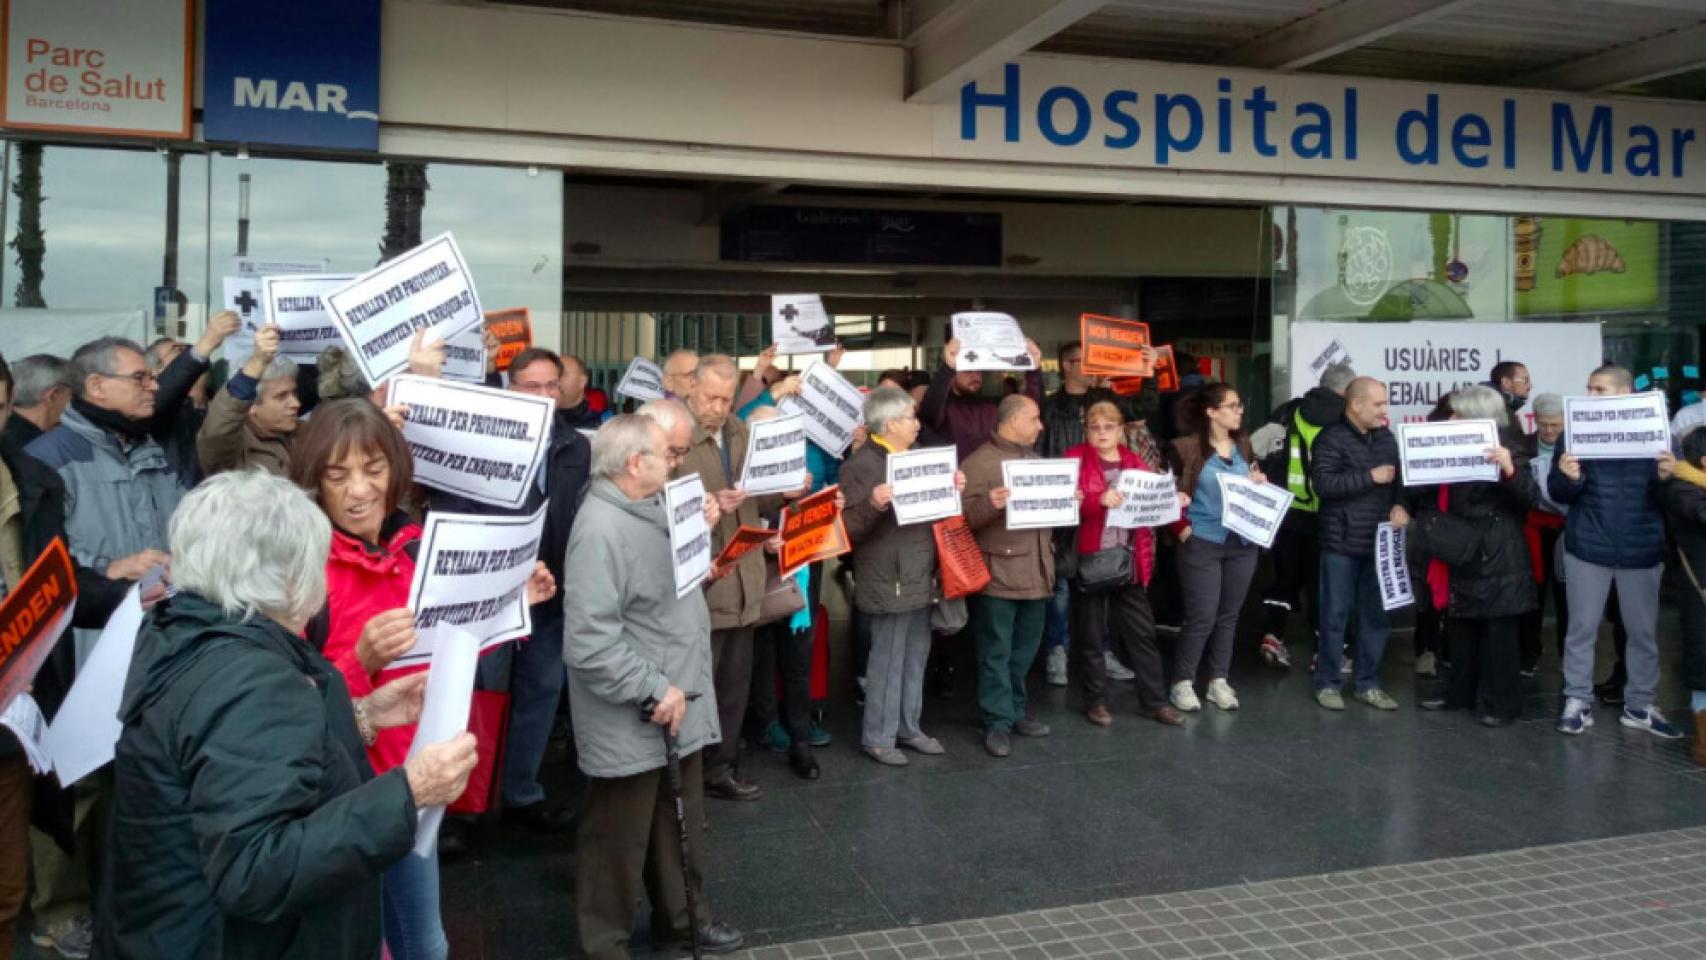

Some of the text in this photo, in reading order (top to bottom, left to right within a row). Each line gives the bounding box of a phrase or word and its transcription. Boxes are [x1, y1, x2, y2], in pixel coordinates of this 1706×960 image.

[26, 38, 105, 69] Parc
[25, 68, 166, 101] de Salut
[26, 95, 111, 112] Barcelona
[959, 62, 1694, 178] Hospital del Mar
[1384, 340, 1481, 372] USUÀRIES
[448, 409, 469, 433] PER
[444, 453, 467, 472] PER
